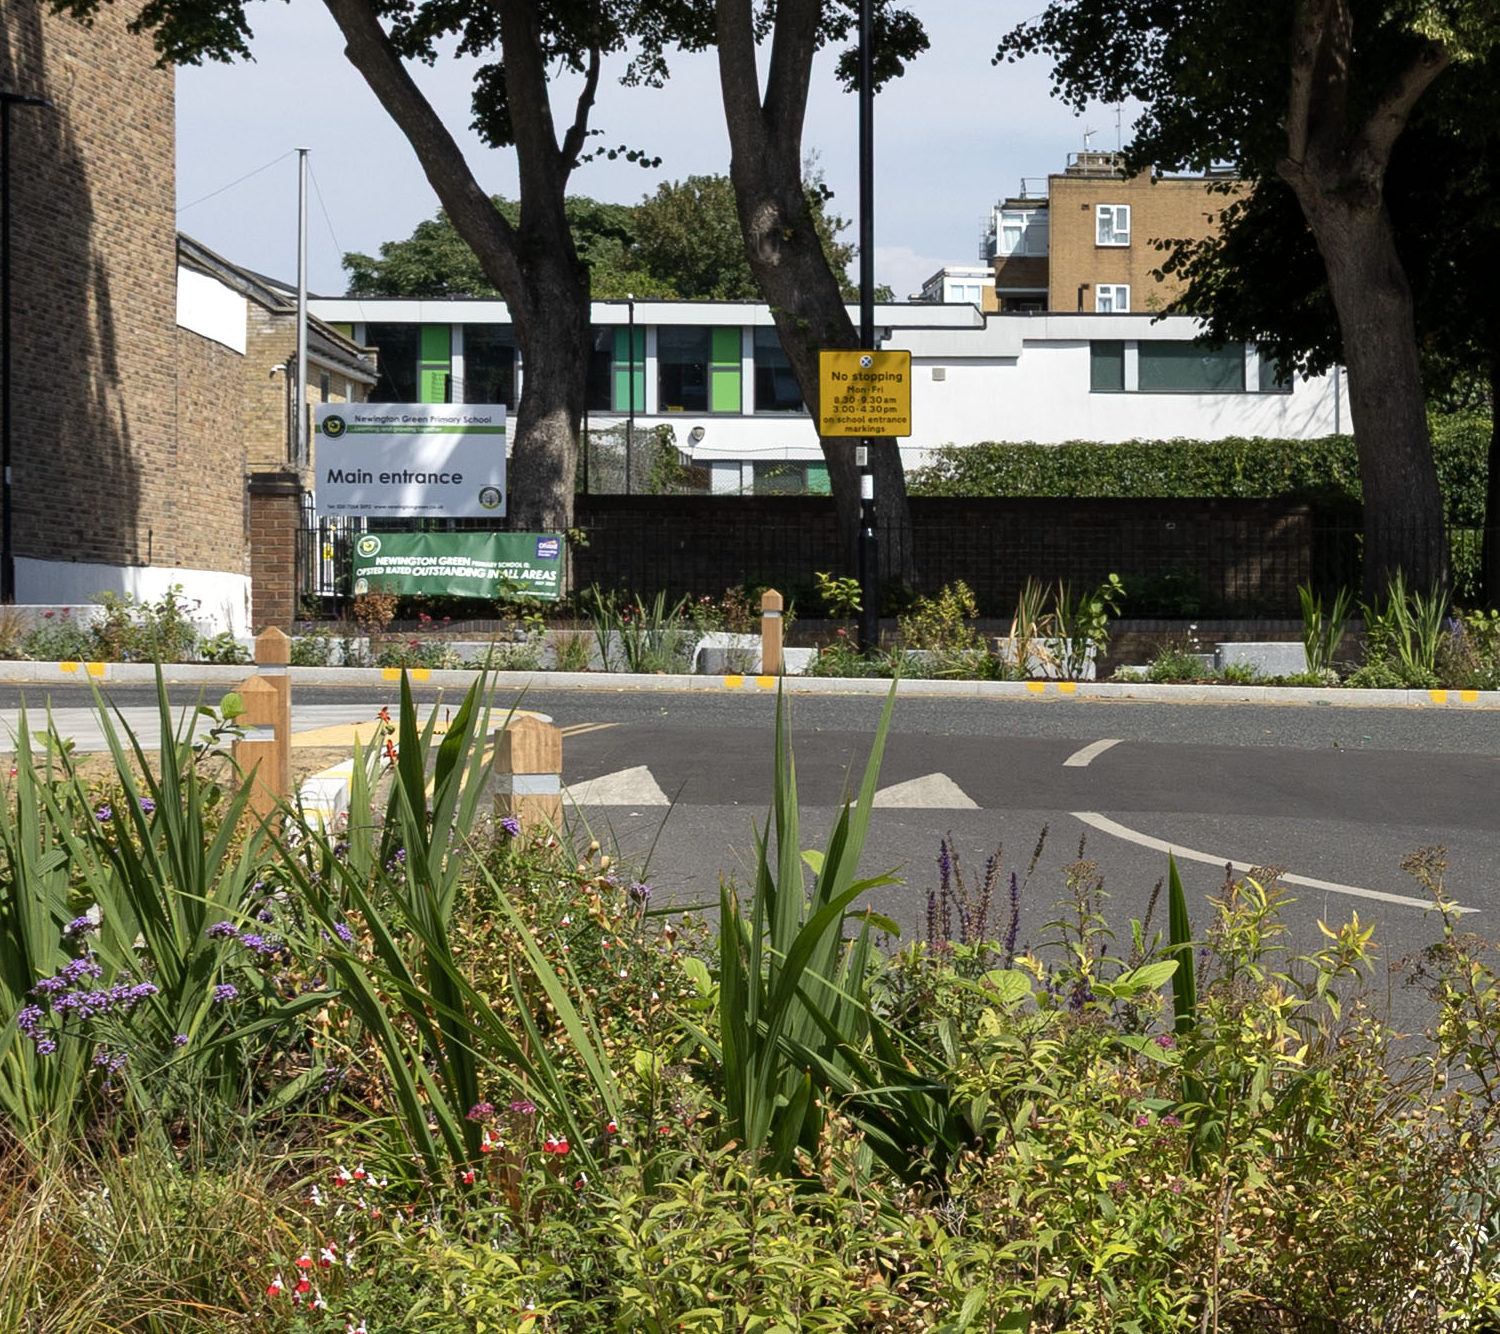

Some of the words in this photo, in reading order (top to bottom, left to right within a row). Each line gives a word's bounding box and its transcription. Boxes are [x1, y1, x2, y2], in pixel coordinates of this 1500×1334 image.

[831, 371, 848, 381] No
[852, 371, 903, 382] stopping
[354, 415, 400, 424] Newington
[402, 415, 428, 423] Green
[430, 415, 460, 424] Primary
[463, 415, 492, 424] School
[837, 415, 865, 423] school
[327, 469, 373, 484] Main
[379, 469, 463, 484] entrance
[375, 556, 437, 566] NEWINGTON
[438, 556, 471, 567] GREEN
[356, 566, 384, 577] OFSTED
[385, 565, 411, 576] RATED
[412, 566, 486, 578] OUTSTANDING
[487, 569, 501, 579] IN
[521, 570, 557, 581] AREAS
